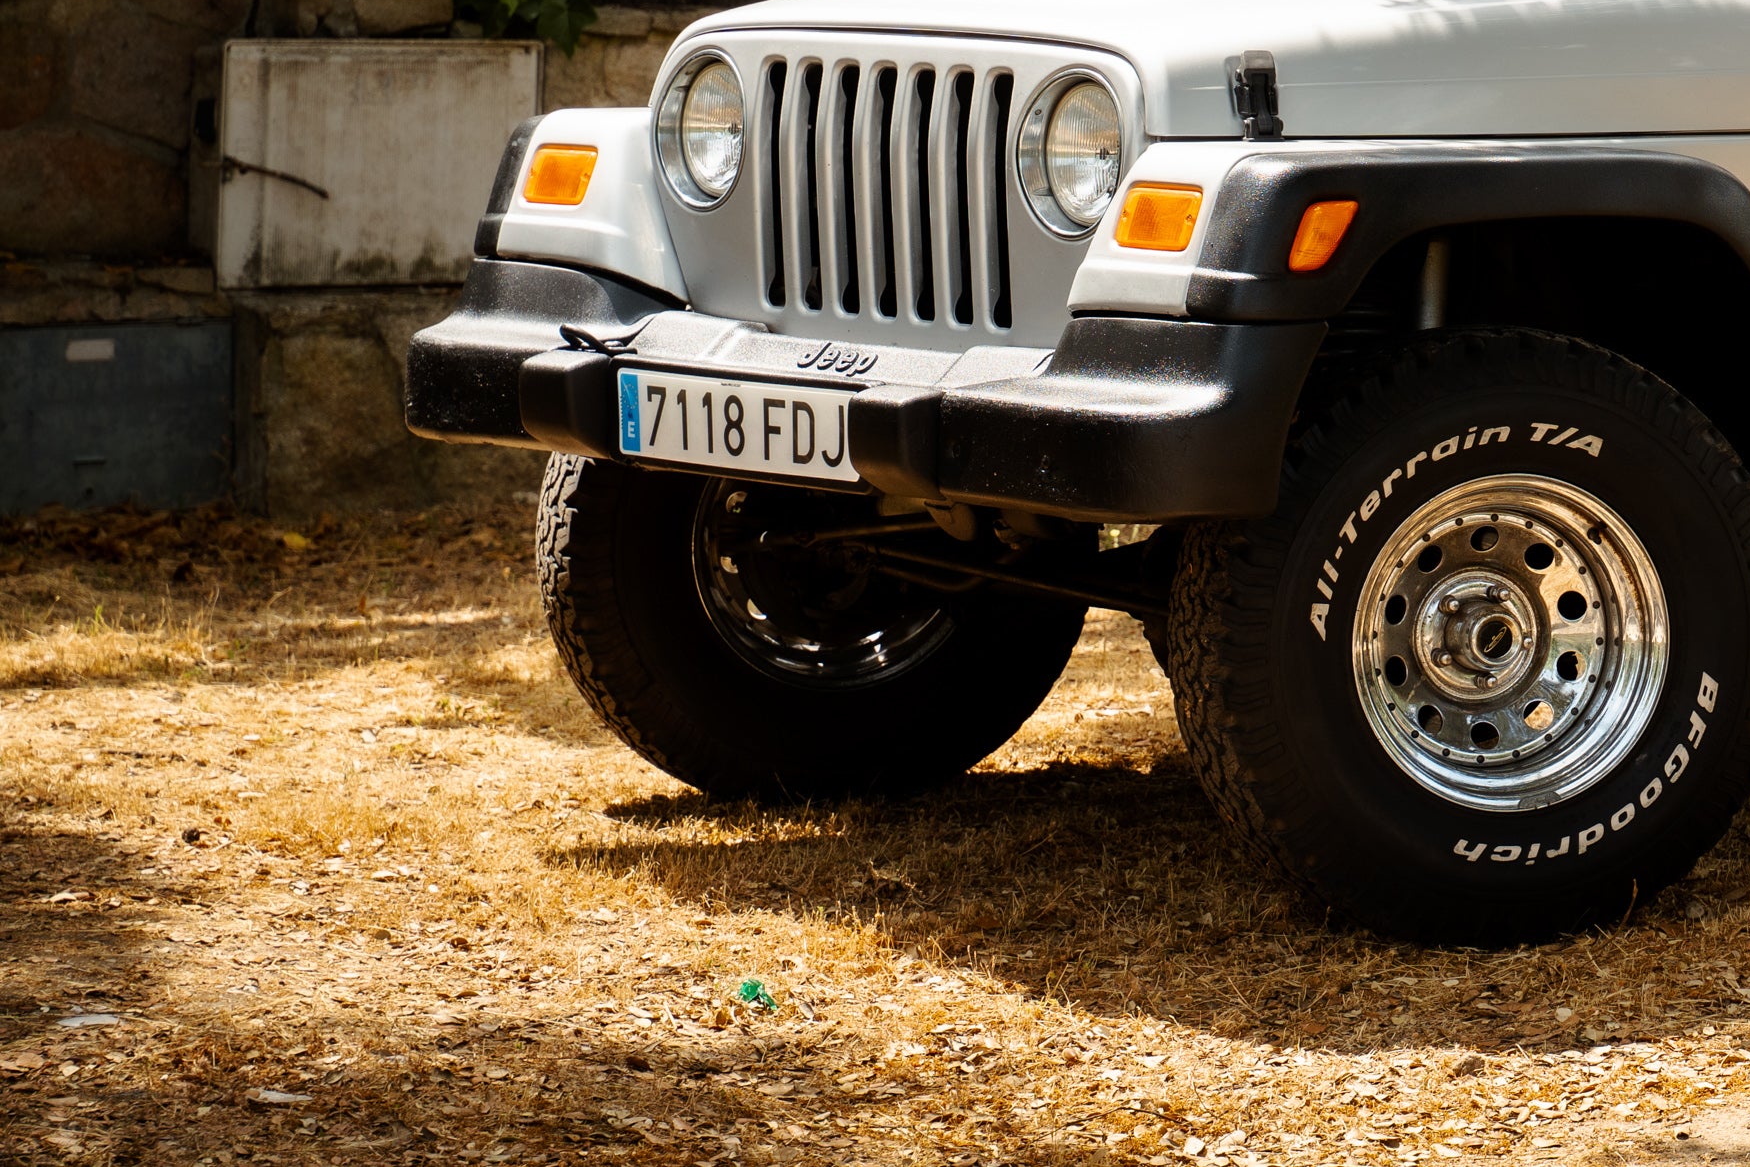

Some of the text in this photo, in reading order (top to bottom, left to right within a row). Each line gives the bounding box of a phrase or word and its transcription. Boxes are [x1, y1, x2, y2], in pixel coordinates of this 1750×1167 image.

[797, 342, 879, 377] Jeep
[627, 420, 636, 438] E
[646, 385, 845, 468] 7118 FDJ
[1310, 422, 1606, 642] All-Terrain T/A
[1452, 671, 1719, 865] BFGoodrich
